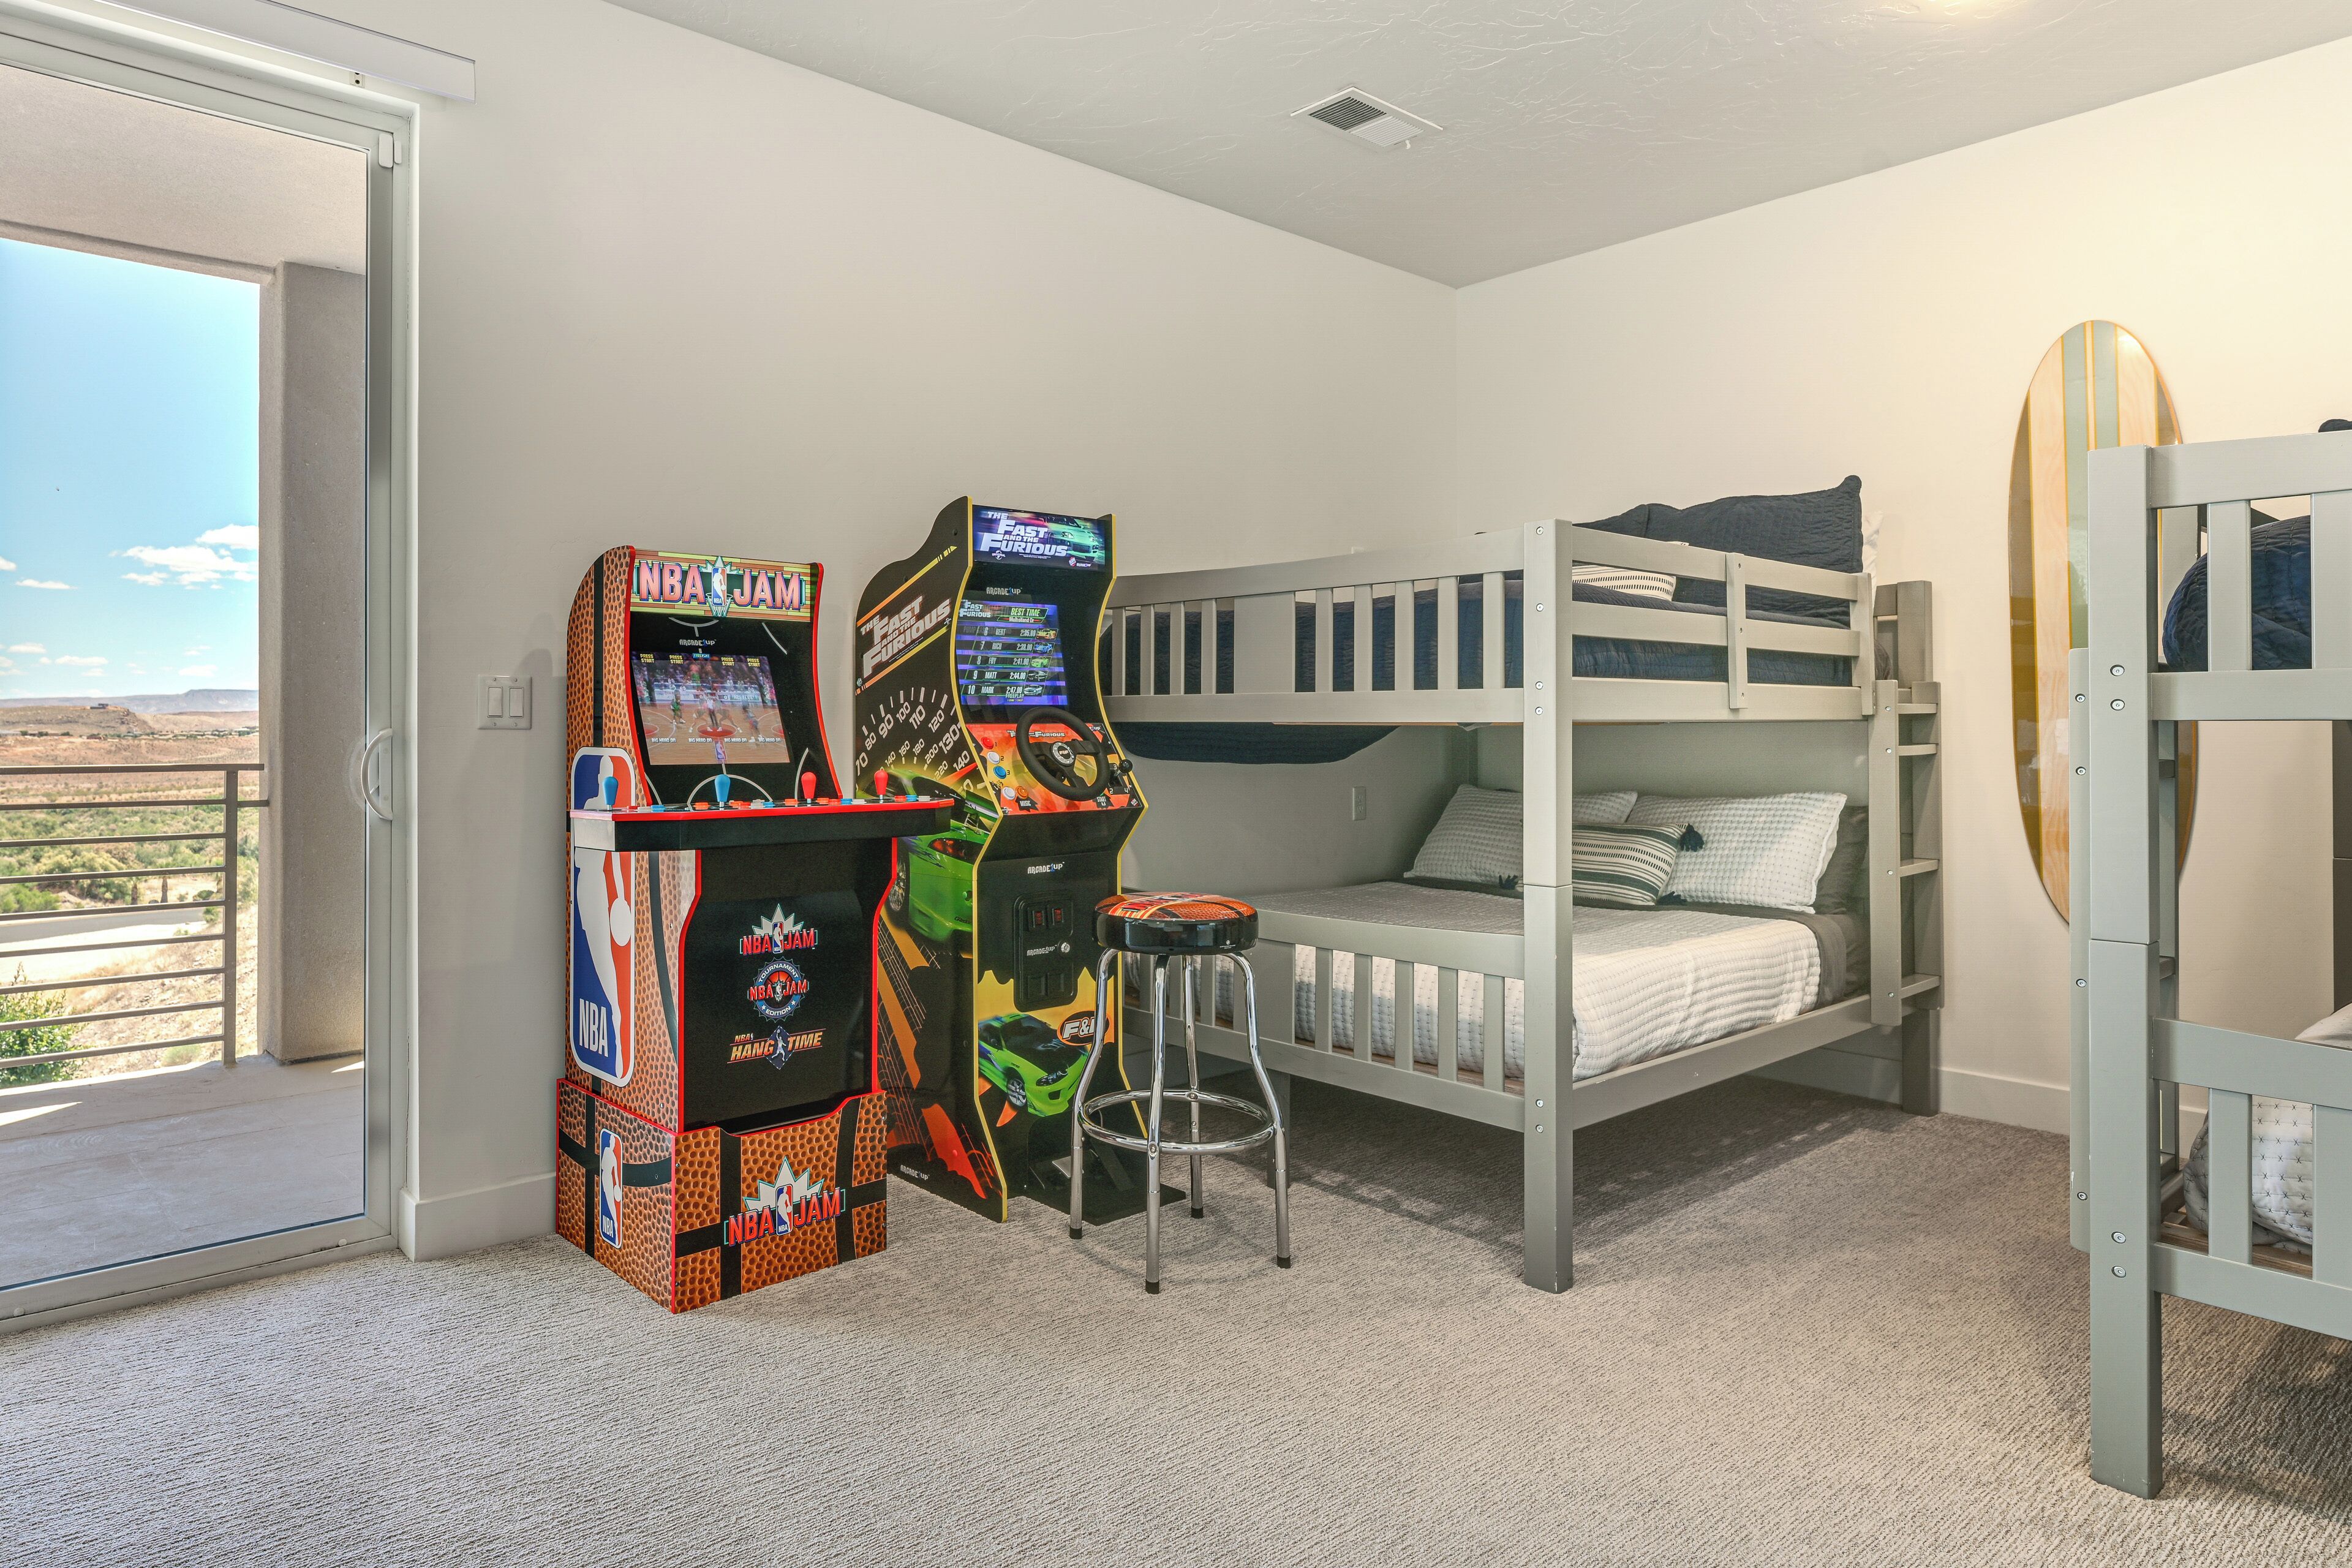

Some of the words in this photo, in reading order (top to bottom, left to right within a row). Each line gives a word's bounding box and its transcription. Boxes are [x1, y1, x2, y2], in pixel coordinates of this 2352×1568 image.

[997, 519, 1048, 538] FAST
[979, 532, 1068, 557] FURIOUS
[639, 560, 706, 605] NBA
[733, 568, 801, 610] JAM
[873, 595, 923, 644] FAST
[959, 608, 991, 618] FURIOUS
[1011, 608, 1025, 616] BEST
[1026, 608, 1041, 617] TIME
[860, 614, 880, 636] THE
[881, 630, 899, 647] AND
[899, 616, 916, 633] THE
[863, 598, 951, 679] FURIOUS
[980, 641, 985, 650] 7
[973, 671, 978, 680] 9
[968, 685, 976, 695] 10
[896, 701, 911, 723] 100
[909, 705, 925, 729] 110
[928, 709, 944, 733] 120
[878, 714, 894, 739] 90
[865, 732, 876, 751] 80
[899, 740, 910, 757] 160
[913, 738, 925, 756] 180
[938, 724, 960, 755] 130
[884, 751, 896, 767] 140
[924, 744, 939, 765] 200
[952, 750, 970, 772] 140
[934, 760, 948, 780] 220
[742, 933, 772, 956] NBA
[783, 928, 815, 950] JAM
[758, 963, 799, 982] TOURNAMENT
[749, 984, 774, 1001] NBA
[783, 979, 808, 996] JAM
[766, 1006, 791, 1016] EDITION
[579, 997, 609, 1058] NBA
[735, 1033, 750, 1043] NBA
[730, 1040, 775, 1061] HANG
[787, 1031, 823, 1051] TIME
[602, 1215, 614, 1238] NBA
[728, 1205, 775, 1246] NBA
[794, 1186, 841, 1228] JAM
[778, 1224, 788, 1232] NBA
